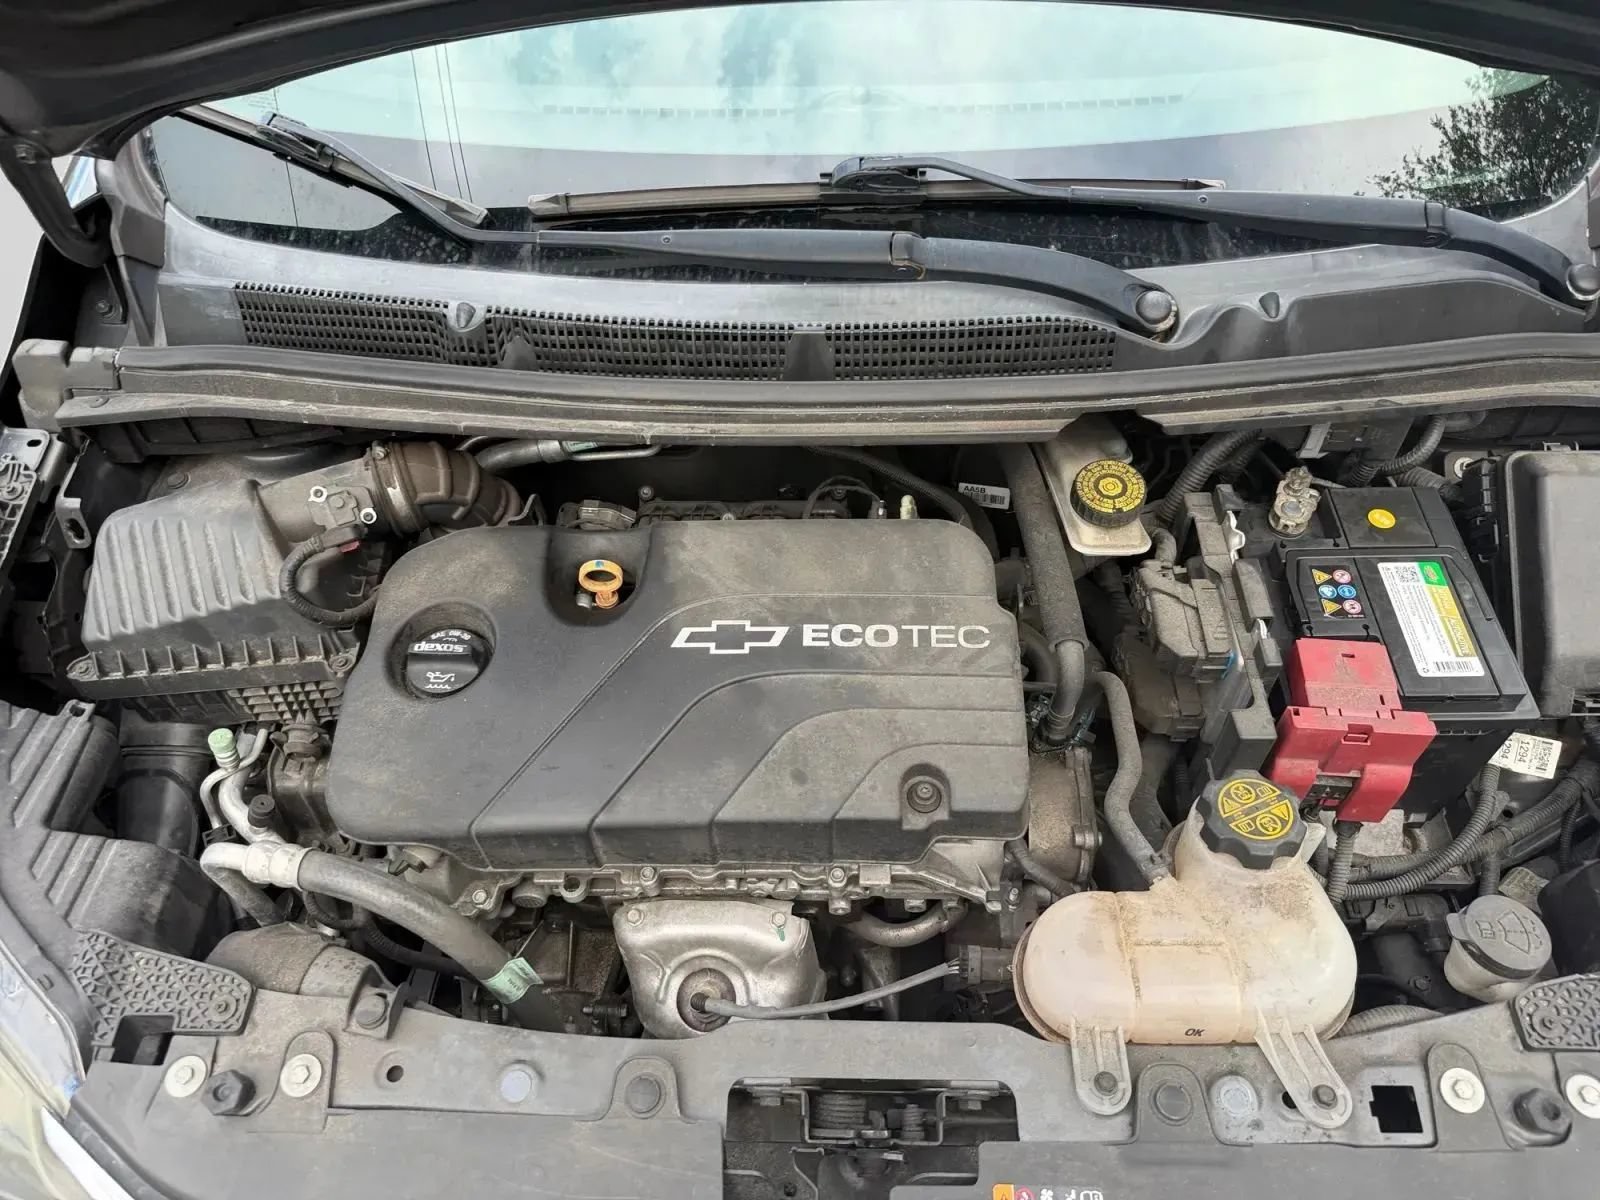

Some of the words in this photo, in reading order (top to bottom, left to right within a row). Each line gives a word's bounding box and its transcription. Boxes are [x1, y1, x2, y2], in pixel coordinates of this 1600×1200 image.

[802, 623, 991, 649] ECOTEC
[413, 641, 464, 653] dexos
[1517, 740, 1530, 763] 1294
[1184, 1028, 1205, 1036] OK
